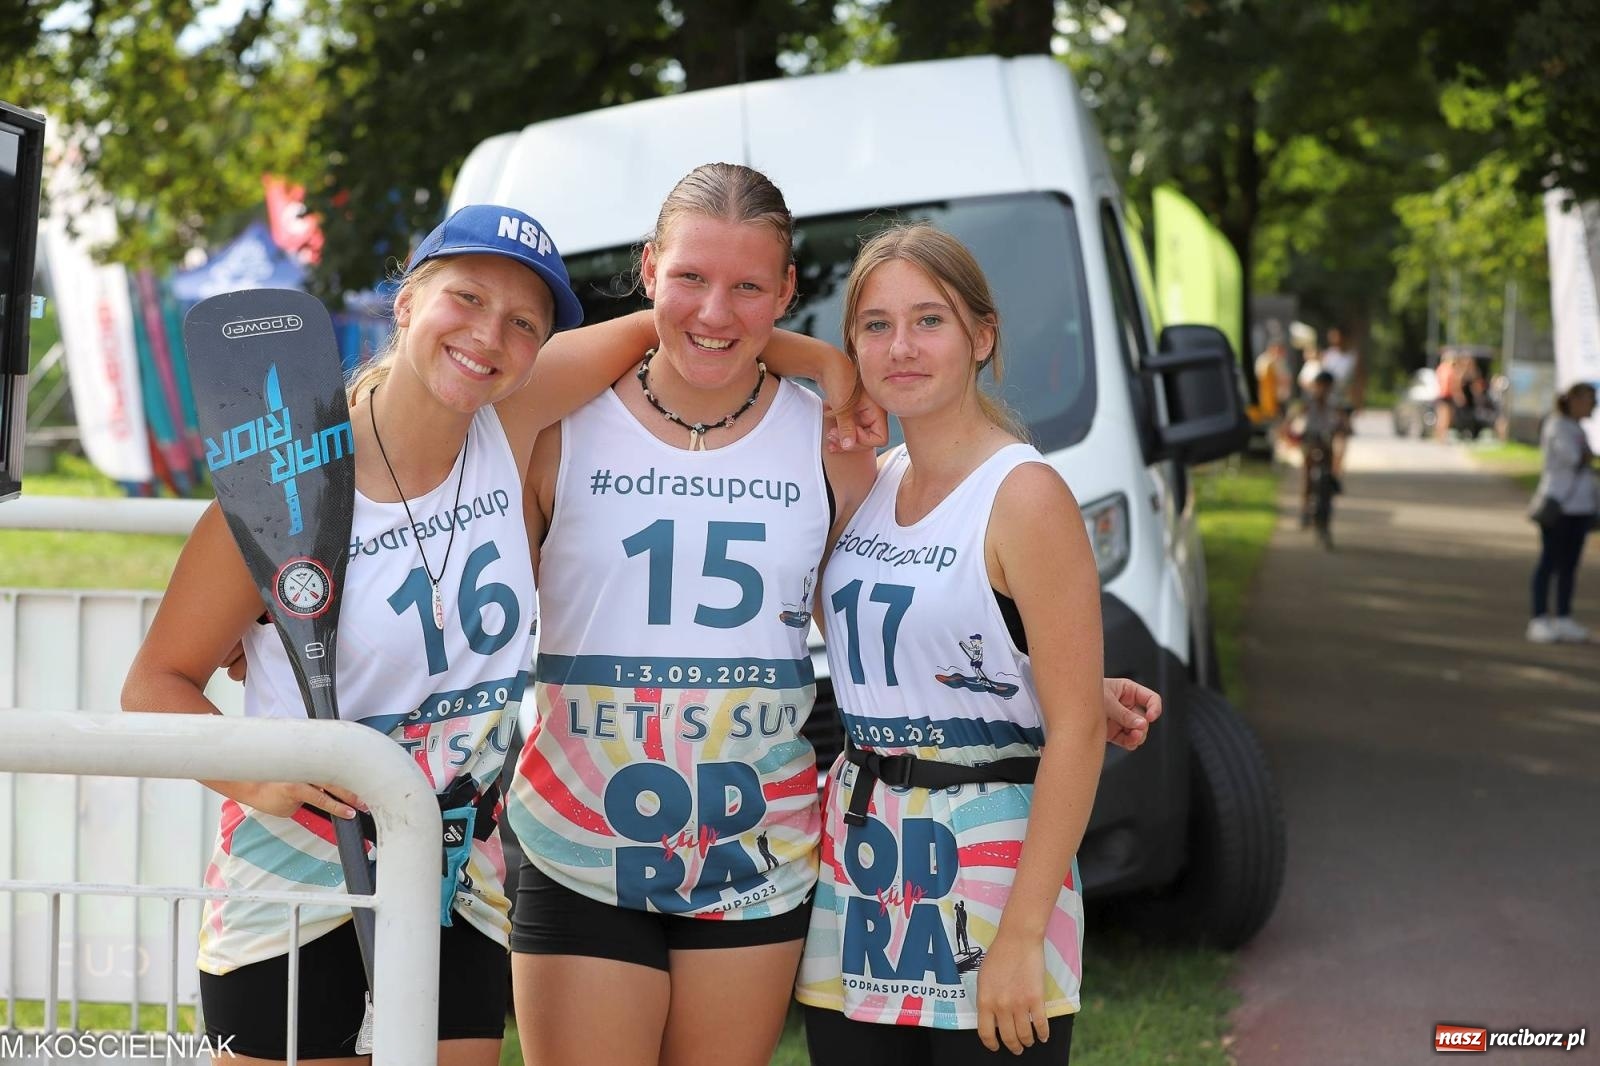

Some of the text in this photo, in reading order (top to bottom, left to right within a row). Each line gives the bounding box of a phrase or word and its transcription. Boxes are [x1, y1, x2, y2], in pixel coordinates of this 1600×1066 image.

[497, 215, 552, 257] NSP
[205, 407, 292, 472] RIOR
[270, 421, 355, 484] WAR
[589, 467, 801, 507] #odrasupcup
[622, 518, 766, 629] 15
[386, 540, 520, 677] 16
[831, 578, 916, 687] 17
[614, 664, 777, 684] 1-3.09.2023
[567, 699, 710, 742] LET'S
[660, 824, 720, 861] sup
[842, 978, 966, 999] #ODRASUPCUP2023
